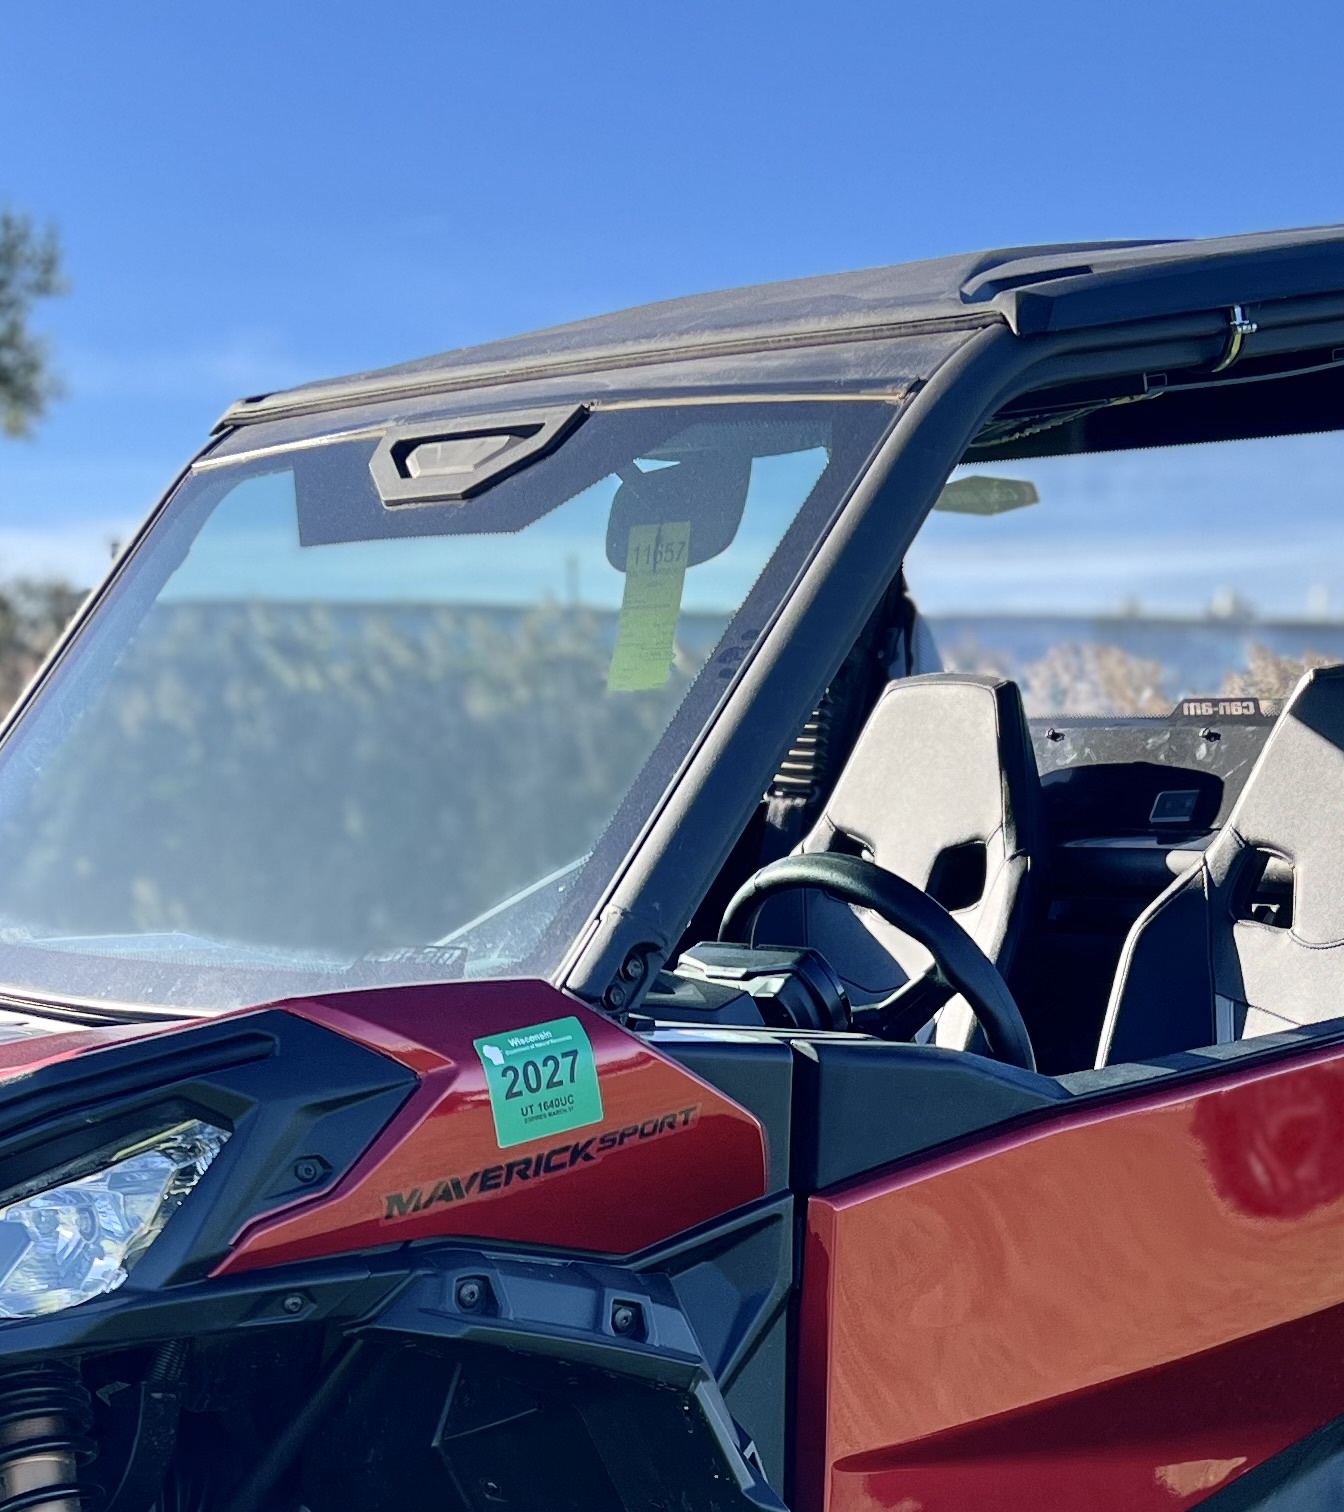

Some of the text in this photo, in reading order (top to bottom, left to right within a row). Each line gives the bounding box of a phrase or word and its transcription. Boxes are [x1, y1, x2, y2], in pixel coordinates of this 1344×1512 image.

[507, 1030, 553, 1047] Wisconsin
[501, 1049, 579, 1100] 2027
[520, 1103, 535, 1117] UT
[384, 1106, 699, 1221] MAVERICK SPORT
